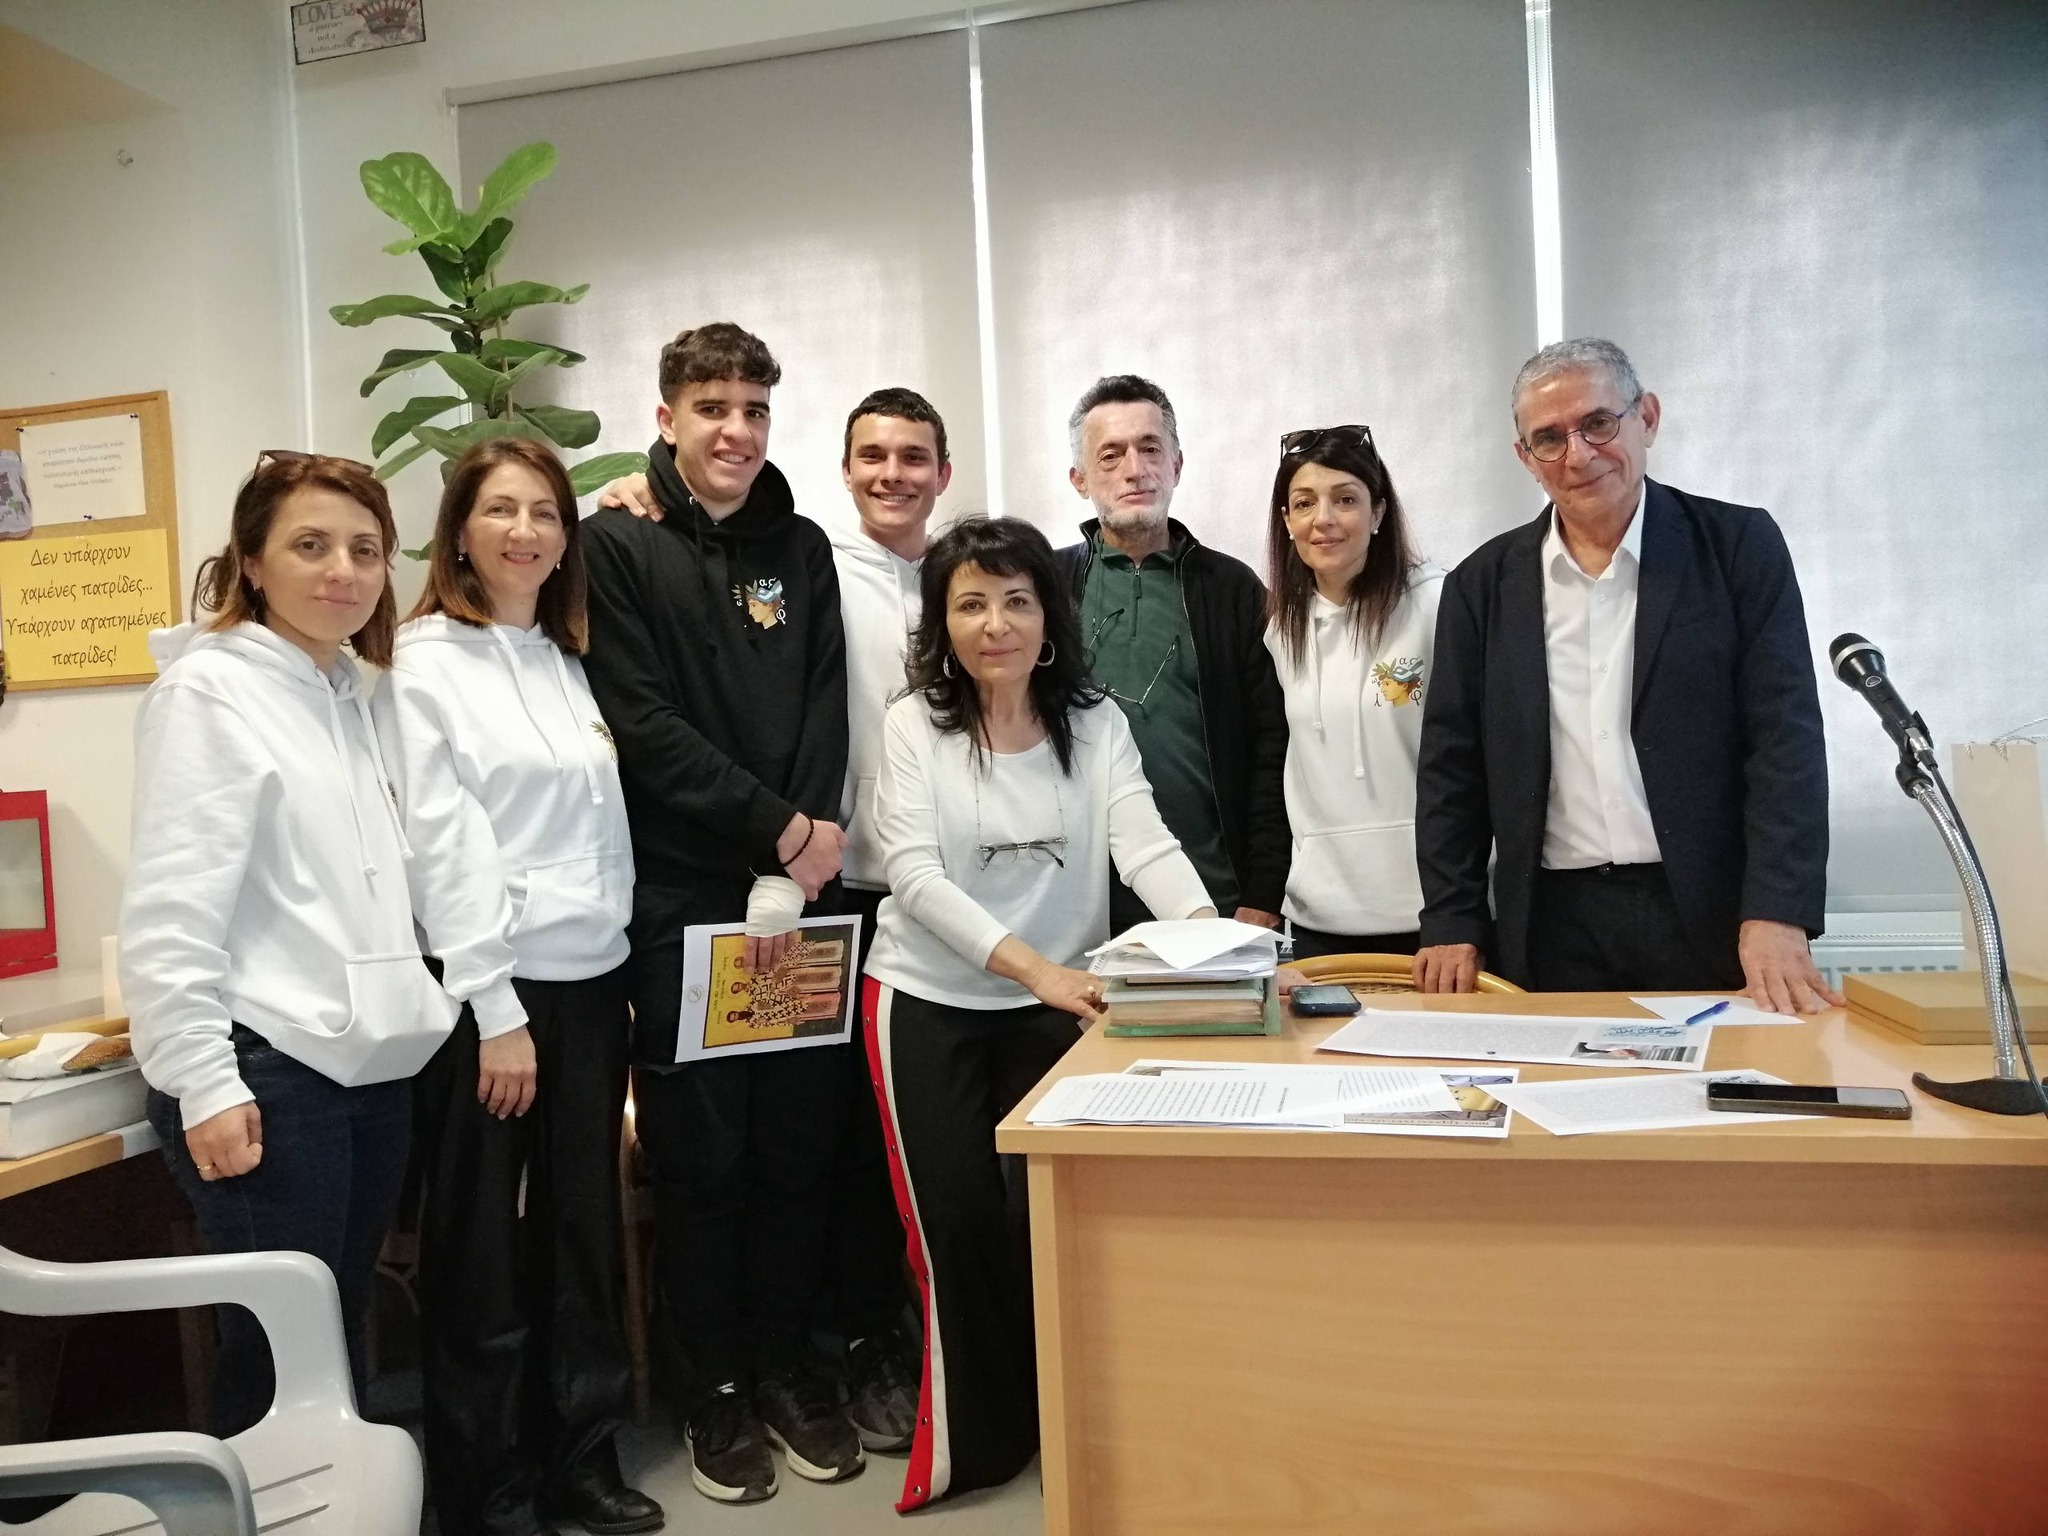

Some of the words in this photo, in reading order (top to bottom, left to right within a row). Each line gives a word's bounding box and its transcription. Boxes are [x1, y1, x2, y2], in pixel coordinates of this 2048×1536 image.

[298, 2, 342, 26] LOVE
[30, 549, 58, 566] Δεν
[63, 544, 131, 566] υπάρχουν
[20, 580, 77, 605] χαμένες
[81, 575, 153, 599] πατρίδες...
[6, 616, 76, 637] Υπάρχουν
[80, 607, 167, 635] αγαπημένες
[52, 645, 117, 668] πατρίδες!
